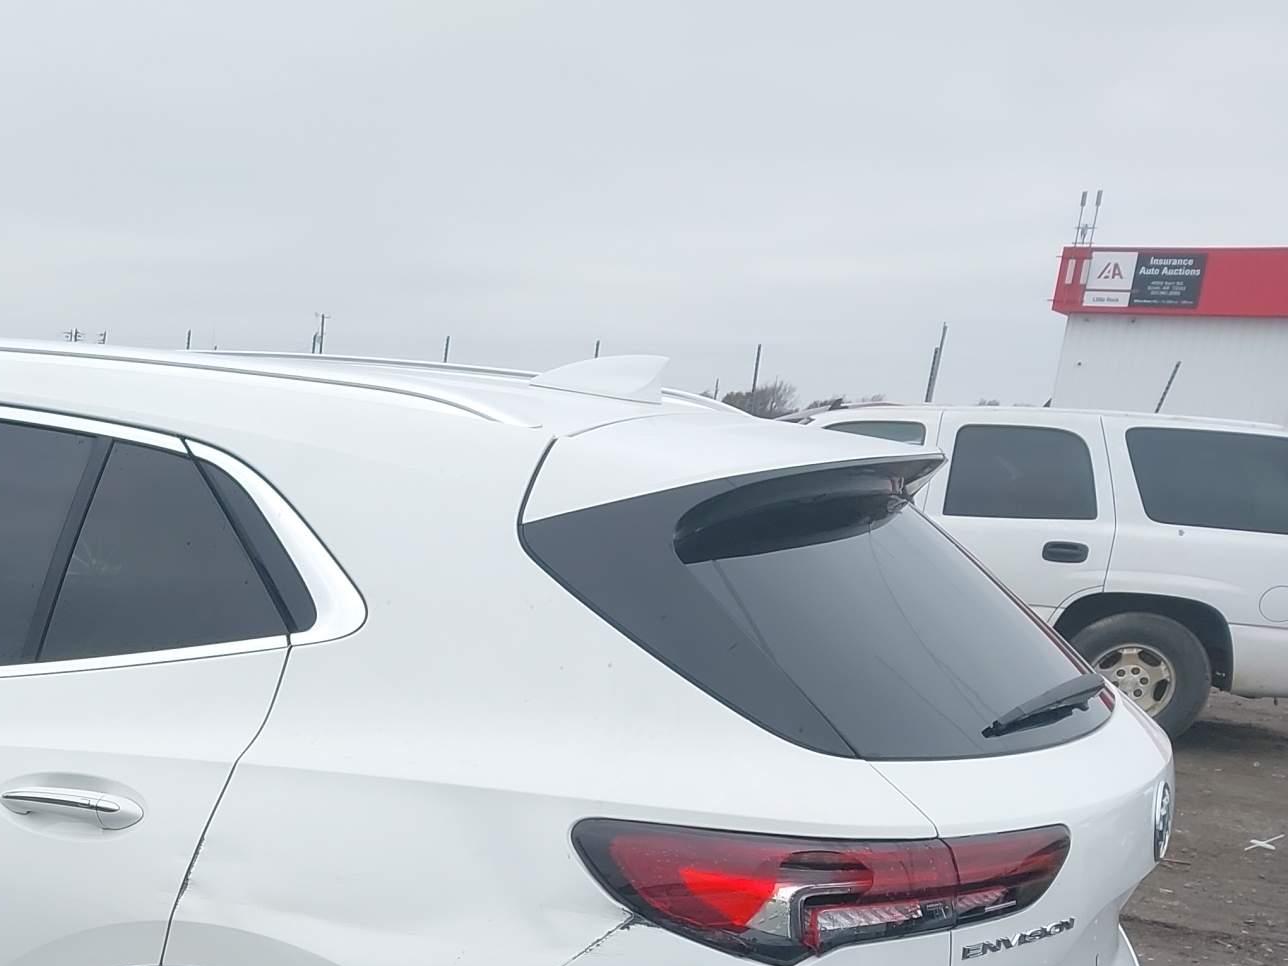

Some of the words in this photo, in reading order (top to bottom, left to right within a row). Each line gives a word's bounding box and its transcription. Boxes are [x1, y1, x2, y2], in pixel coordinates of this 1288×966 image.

[1150, 256, 1194, 266] Insurance
[1139, 266, 1160, 275] Auto
[1161, 266, 1201, 276] Auctions
[962, 917, 1075, 960] ENVISION
